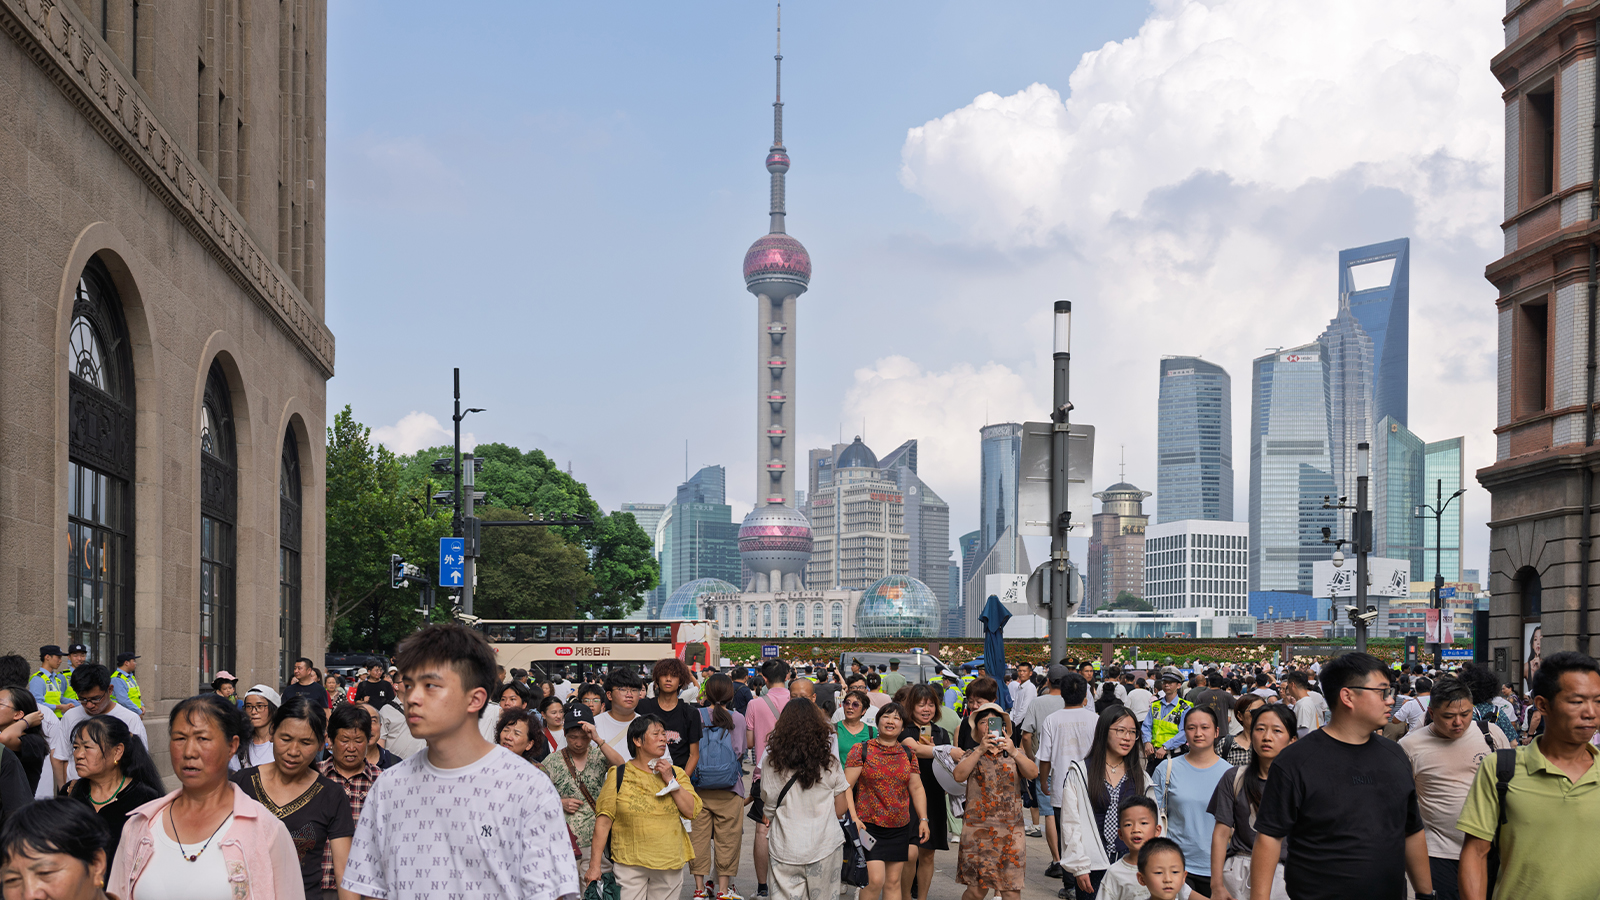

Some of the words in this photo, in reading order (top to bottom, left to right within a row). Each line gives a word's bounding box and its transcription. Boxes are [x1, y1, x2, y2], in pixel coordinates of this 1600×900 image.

[480, 766, 499, 776] NY
[502, 762, 520, 770] NY
[394, 778, 409, 786] NY
[422, 774, 437, 782] NY
[458, 774, 476, 783] NY
[516, 773, 533, 782] NY
[438, 785, 455, 794] NY
[494, 780, 512, 790] NY
[380, 790, 393, 800] NY
[407, 786, 421, 796] NY
[473, 788, 490, 798] NY
[420, 796, 436, 806] NY
[453, 797, 470, 806] NY
[508, 793, 524, 804] NY
[393, 800, 406, 809] NY
[488, 802, 504, 812] NY
[382, 813, 392, 823] NY
[405, 809, 420, 818] NY
[436, 808, 451, 818] NY
[469, 810, 485, 821] NY
[544, 808, 559, 820] NY
[418, 820, 434, 829] NY
[451, 820, 466, 831] NY
[502, 816, 516, 827] NY
[392, 822, 404, 832] NY
[481, 824, 492, 837] NY
[530, 824, 546, 836] NY
[402, 833, 418, 842] NY
[434, 832, 450, 842] NY
[550, 831, 564, 841] NY
[352, 838, 369, 849] NY
[416, 844, 432, 854] NY
[450, 846, 464, 856] NY
[482, 849, 496, 858] NY
[537, 847, 551, 858] NY
[364, 854, 378, 866] NY
[400, 857, 416, 866] NY
[432, 856, 449, 866] NY
[466, 858, 482, 868] NY
[553, 854, 568, 862] NY
[347, 858, 362, 870] NY
[522, 862, 538, 874] NY
[416, 868, 430, 878] NY
[450, 869, 464, 879] NY
[484, 870, 498, 880] NY
[543, 868, 556, 879] NY
[358, 874, 374, 884] NY
[560, 874, 574, 884] NY
[400, 881, 414, 890] NY
[431, 880, 448, 890] NY
[466, 882, 482, 890] NY
[372, 888, 388, 898] NY
